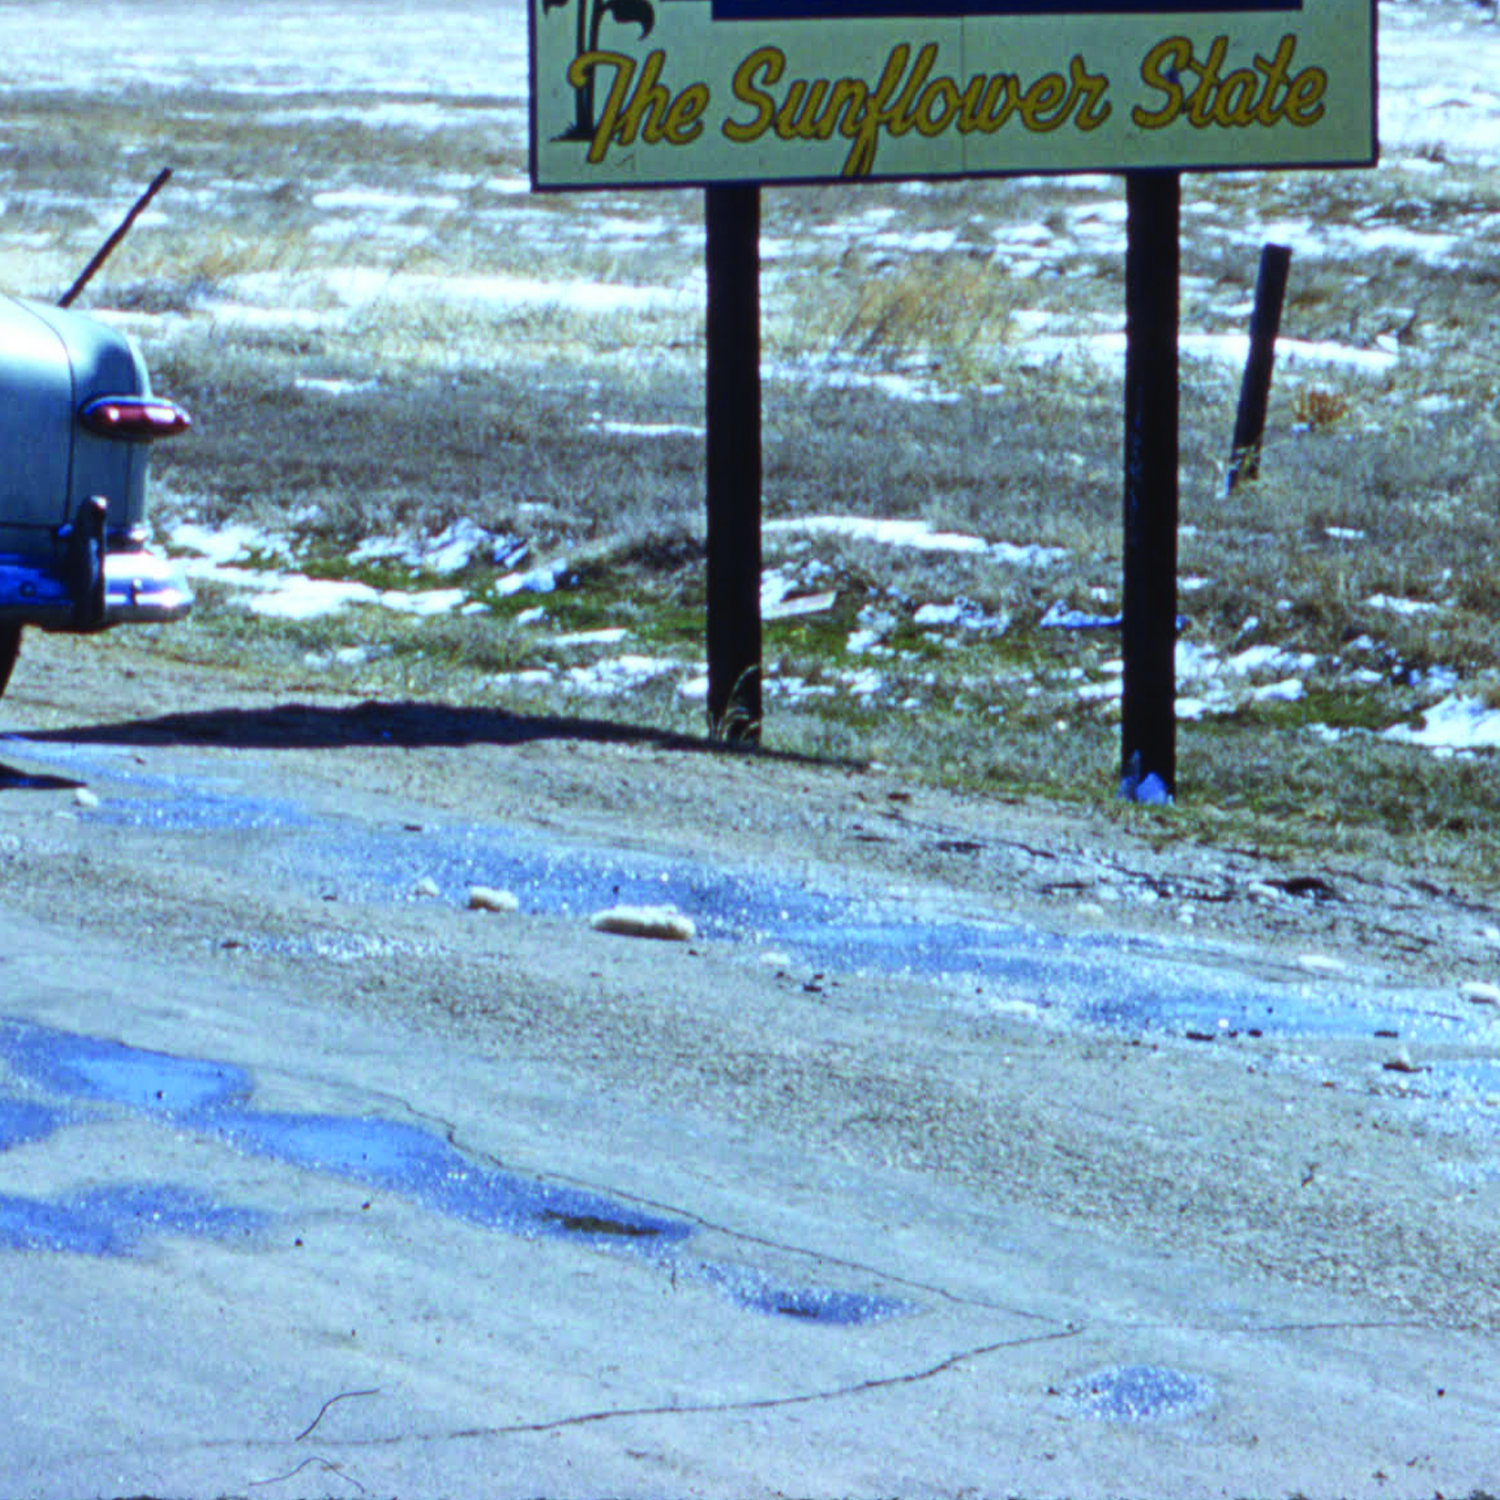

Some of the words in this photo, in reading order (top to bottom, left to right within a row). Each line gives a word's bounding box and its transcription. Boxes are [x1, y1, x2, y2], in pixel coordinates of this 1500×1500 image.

[567, 49, 710, 165] The
[721, 41, 1109, 177] Sunflower
[1131, 33, 1328, 131] State
